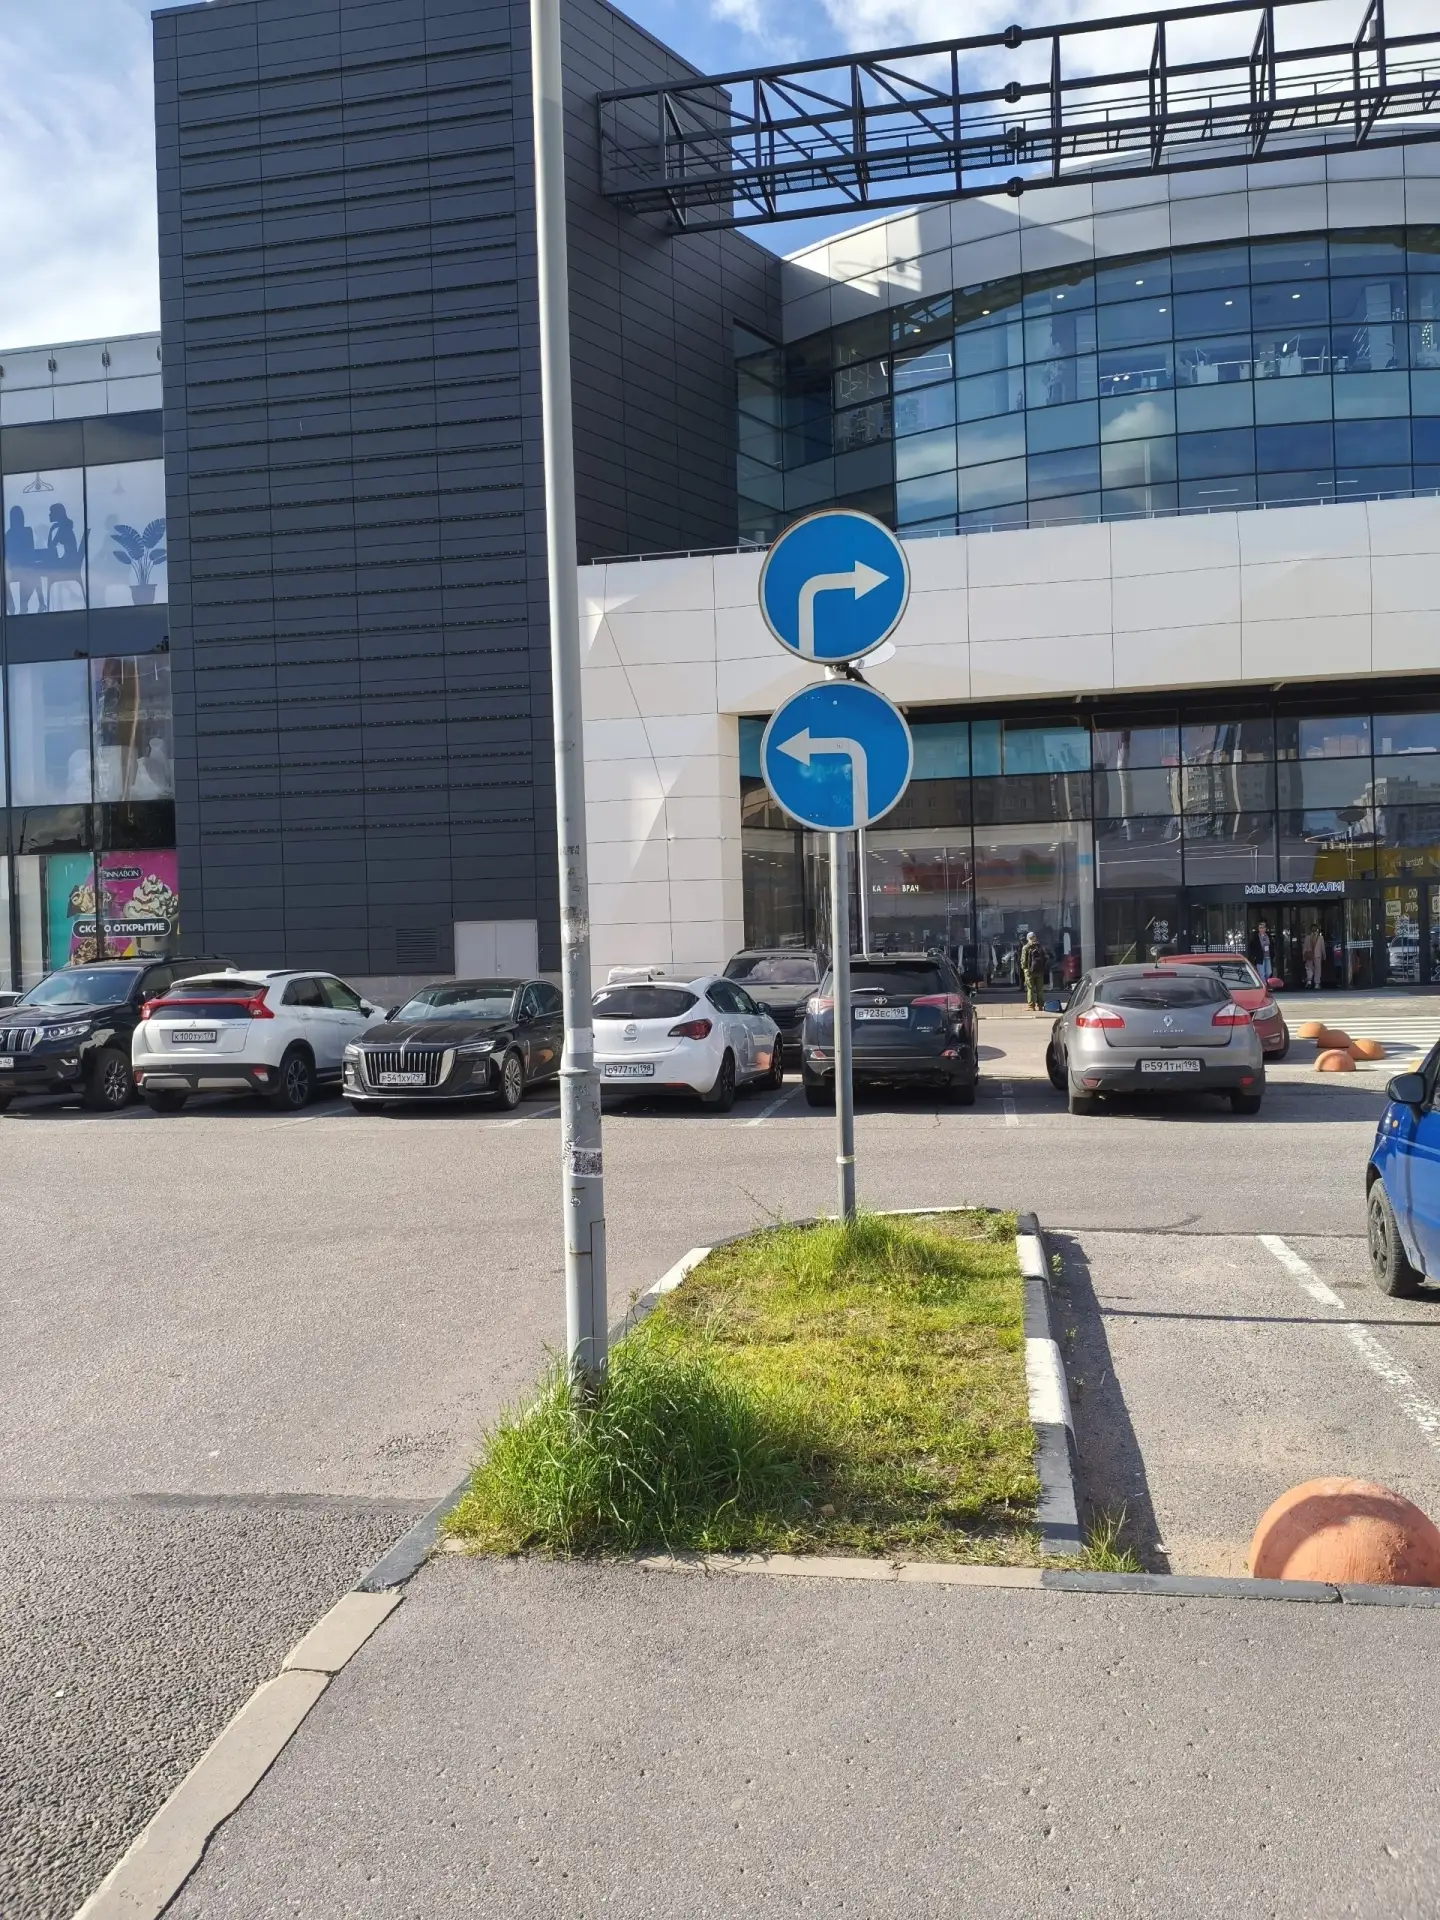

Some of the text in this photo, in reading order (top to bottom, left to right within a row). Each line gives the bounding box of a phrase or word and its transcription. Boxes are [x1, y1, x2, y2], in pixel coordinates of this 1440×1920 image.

[1245, 881, 1345, 894] МЫ ВАС ЖДАЛИ!
[79, 922, 165, 933] СКОО ОТКРЫТИЕ
